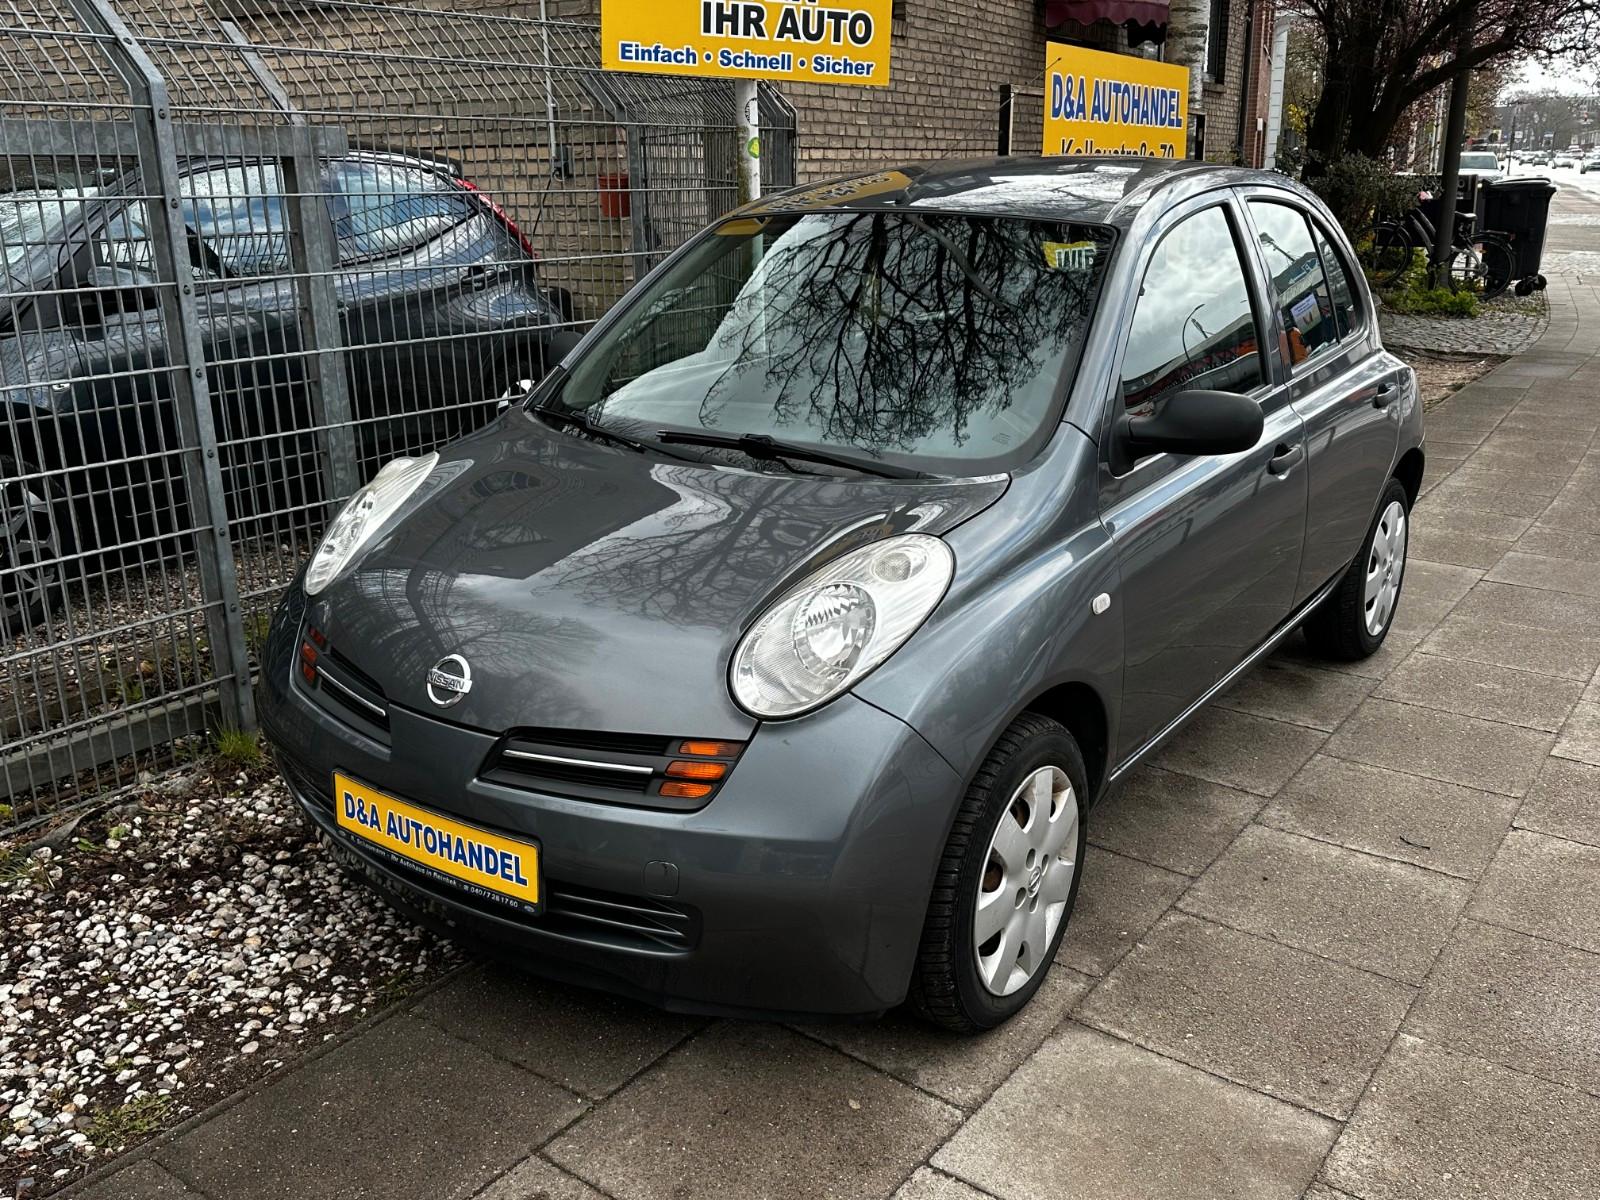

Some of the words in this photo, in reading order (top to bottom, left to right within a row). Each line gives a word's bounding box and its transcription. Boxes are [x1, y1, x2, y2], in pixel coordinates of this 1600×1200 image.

[701, 2, 766, 38] IHR
[776, 6, 873, 44] AUTO
[619, 43, 697, 64] Einfach
[719, 50, 792, 71] Schnell
[812, 56, 874, 76] Sicher
[1051, 73, 1087, 120] D&A
[1090, 79, 1183, 128] AUTOHANDEL
[427, 671, 466, 690] NISSAN
[343, 791, 382, 833] D&A
[386, 810, 529, 887] AUTOHANDEL
